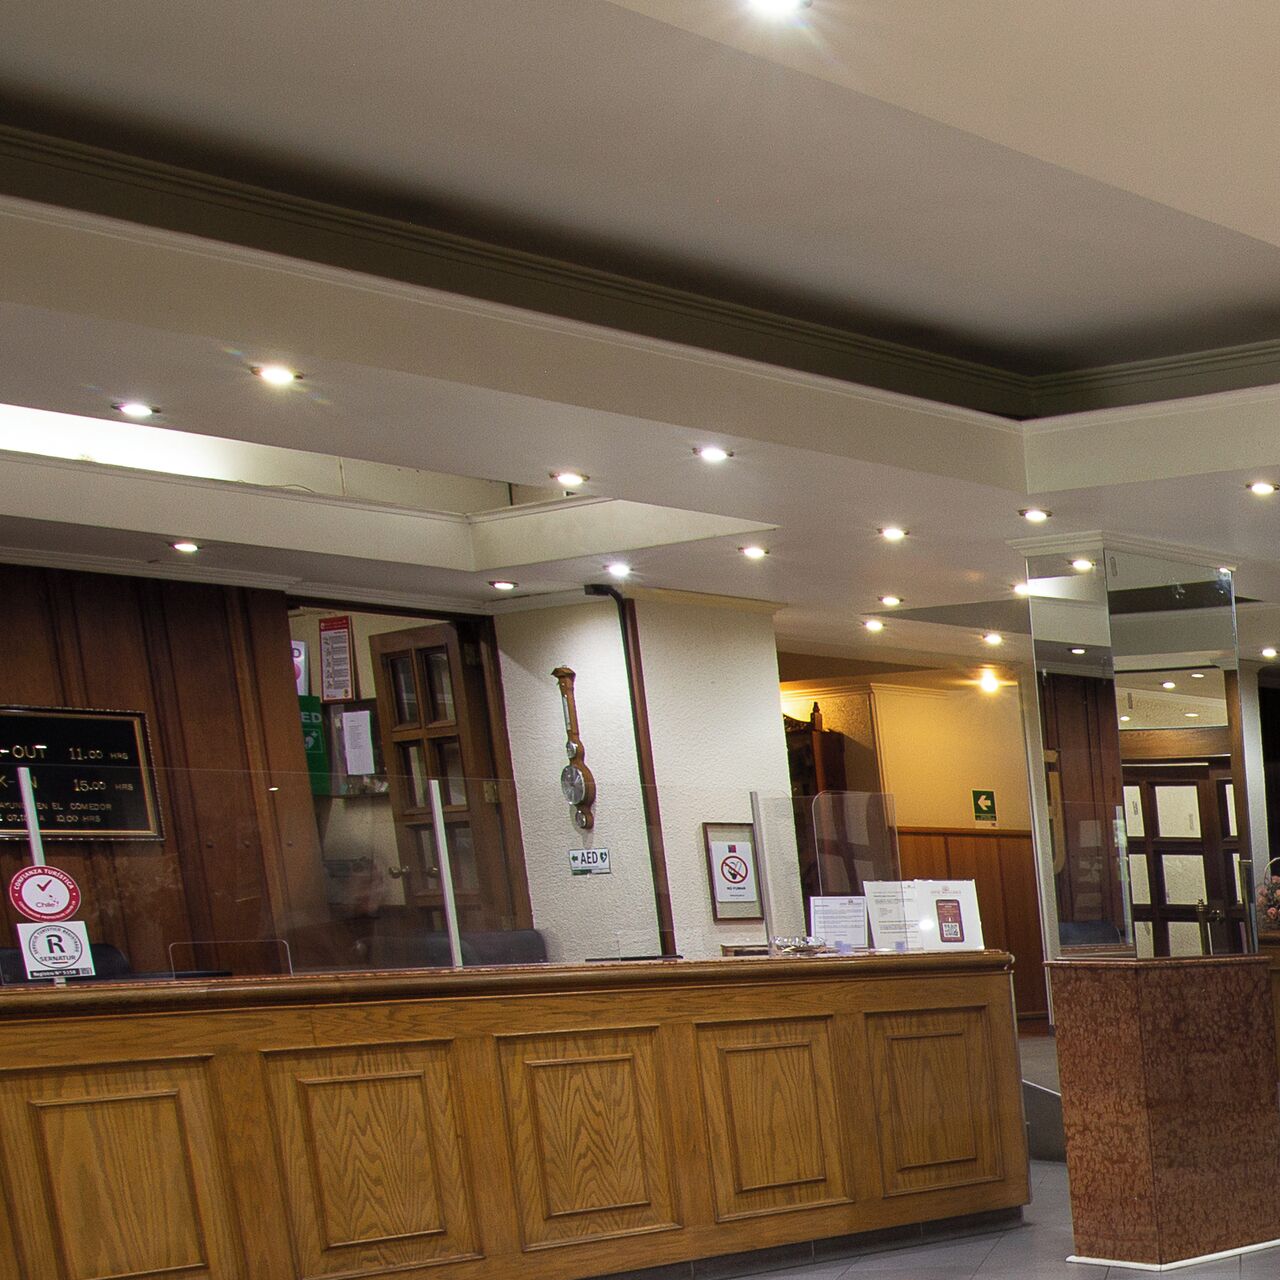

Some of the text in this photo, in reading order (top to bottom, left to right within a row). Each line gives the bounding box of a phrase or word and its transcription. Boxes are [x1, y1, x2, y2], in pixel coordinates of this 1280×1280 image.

[301, 711, 323, 723] ED
[0, 744, 48, 759] -OUT
[70, 803, 112, 811] COMEDOR
[580, 851, 598, 865] AED
[14, 868, 43, 890] CONFIANZA
